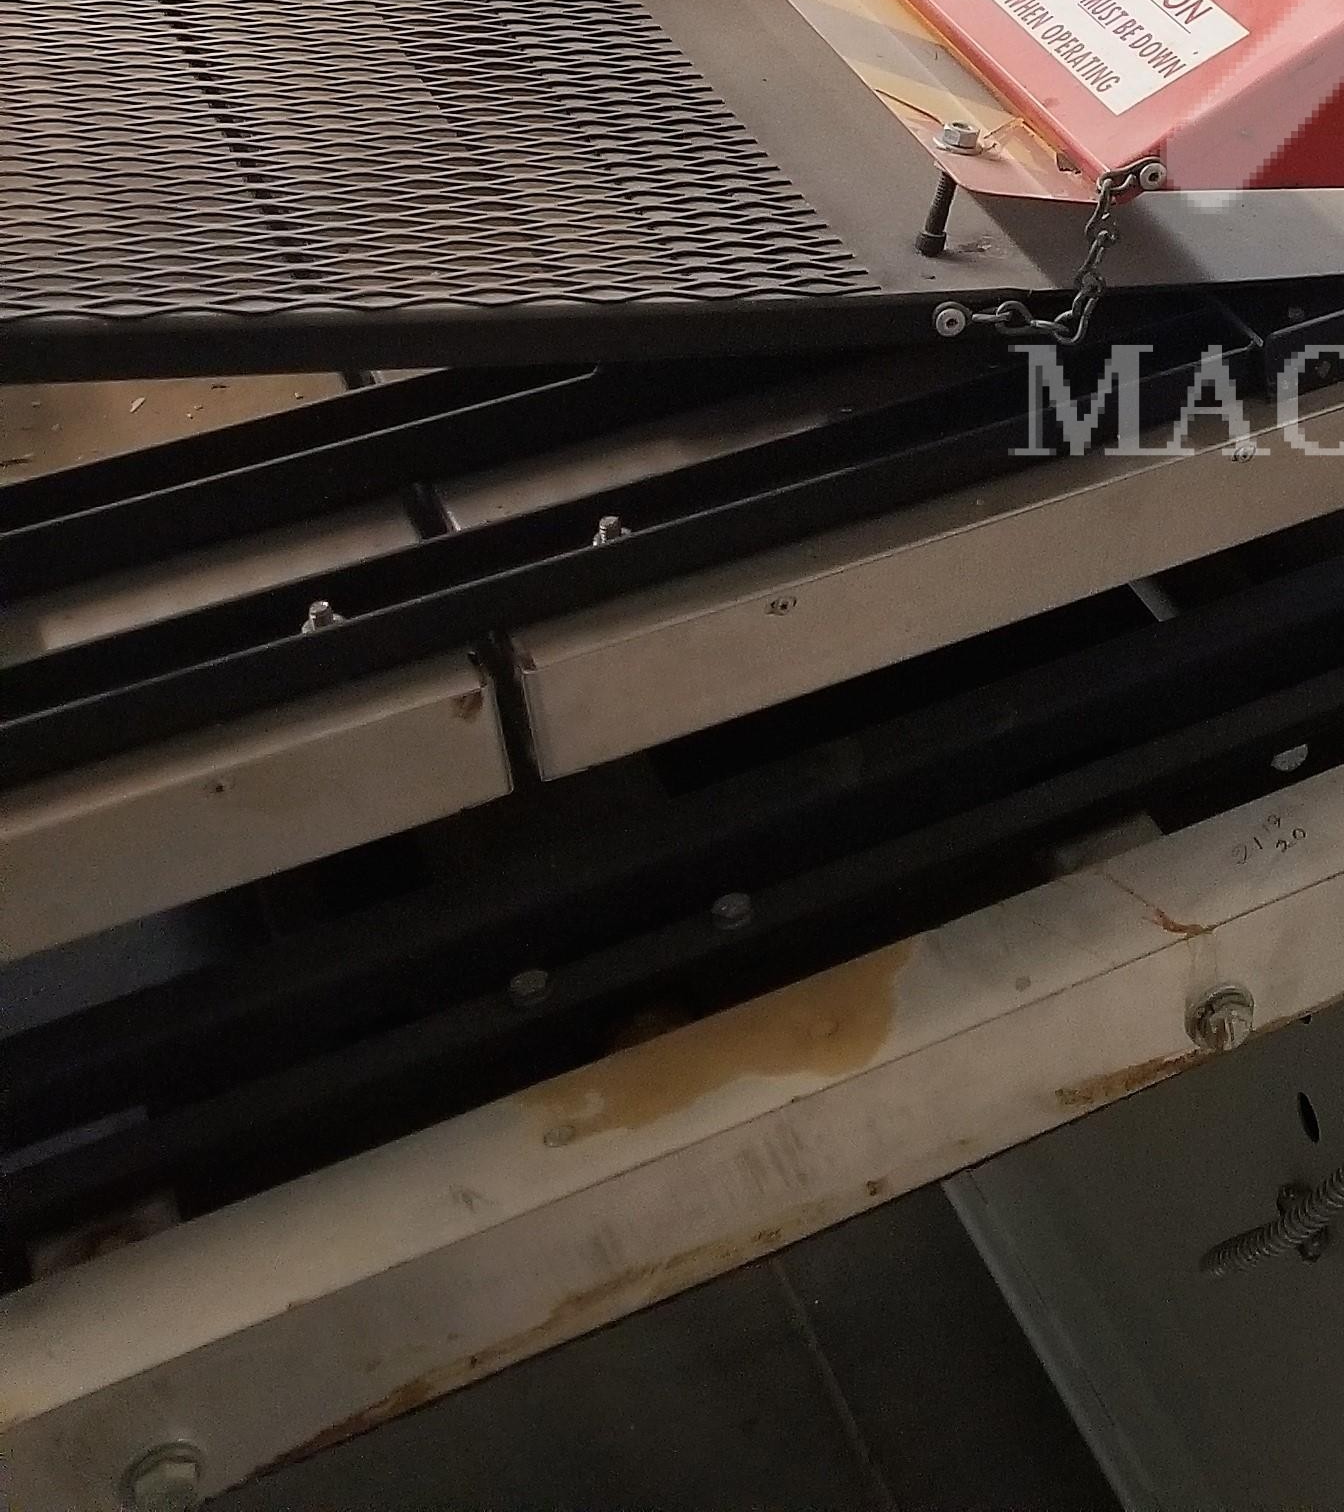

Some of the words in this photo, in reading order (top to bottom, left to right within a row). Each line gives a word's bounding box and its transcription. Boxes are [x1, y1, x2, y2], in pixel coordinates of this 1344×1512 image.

[1041, 24, 1121, 93] OPERATING
[1112, 19, 1144, 41] BE
[1129, 35, 1187, 78] DOWN
